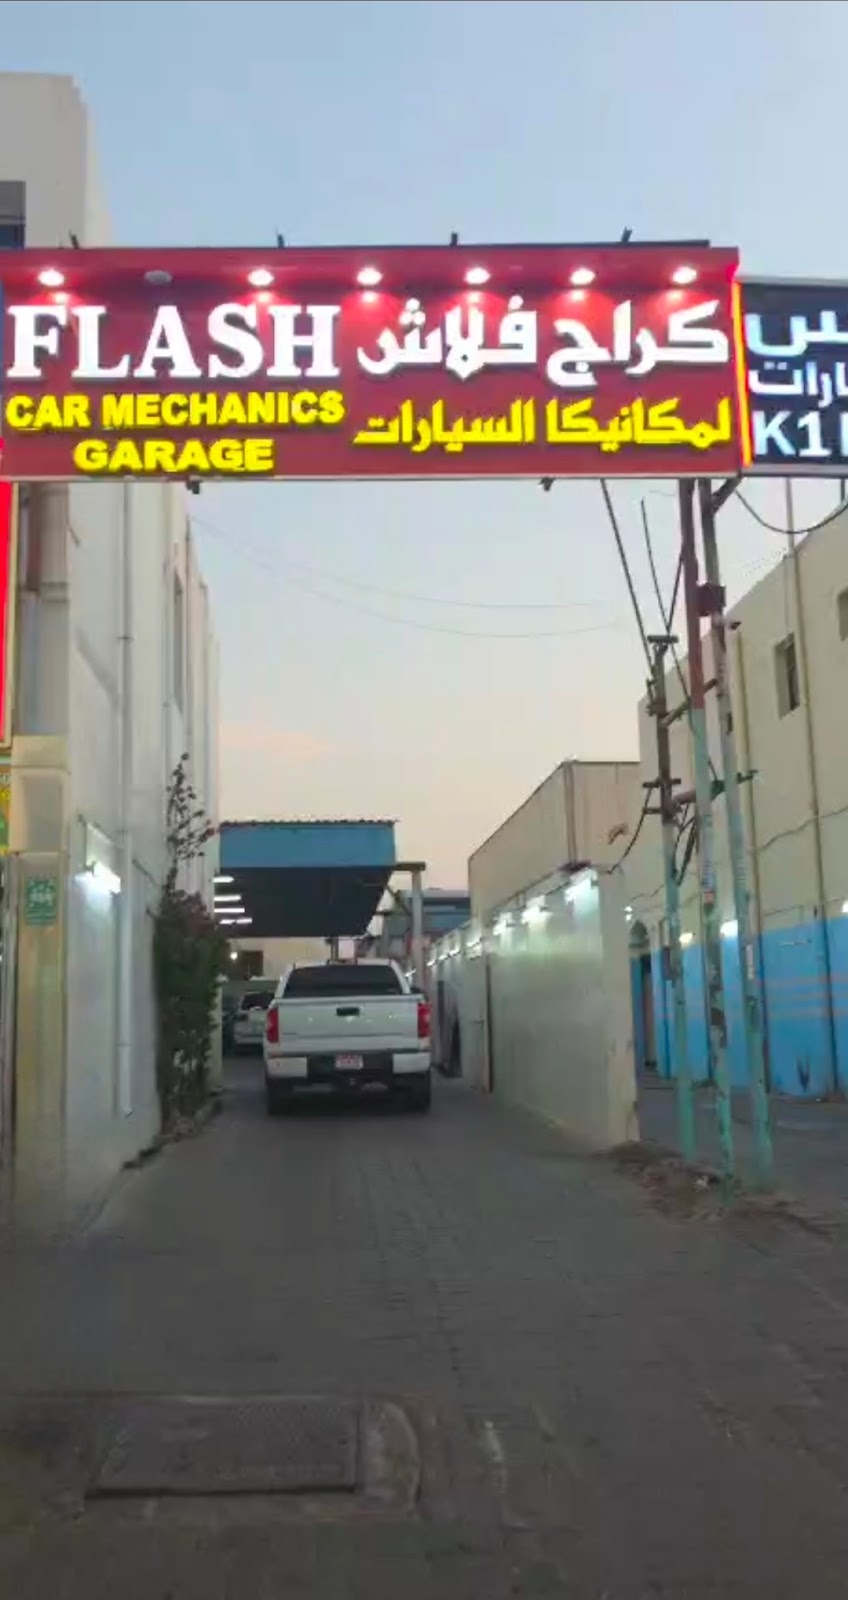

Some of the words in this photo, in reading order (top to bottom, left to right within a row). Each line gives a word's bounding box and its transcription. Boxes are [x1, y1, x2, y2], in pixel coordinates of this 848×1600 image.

[7, 304, 342, 378] FLASH
[356, 298, 538, 380] فلاش
[546, 300, 730, 387] كراج
[6, 394, 92, 430] CAR
[102, 390, 346, 428] MECHANICS
[353, 397, 536, 454] السيارات
[546, 397, 733, 452] لمكانيكا
[73, 438, 275, 472] GARAGE
